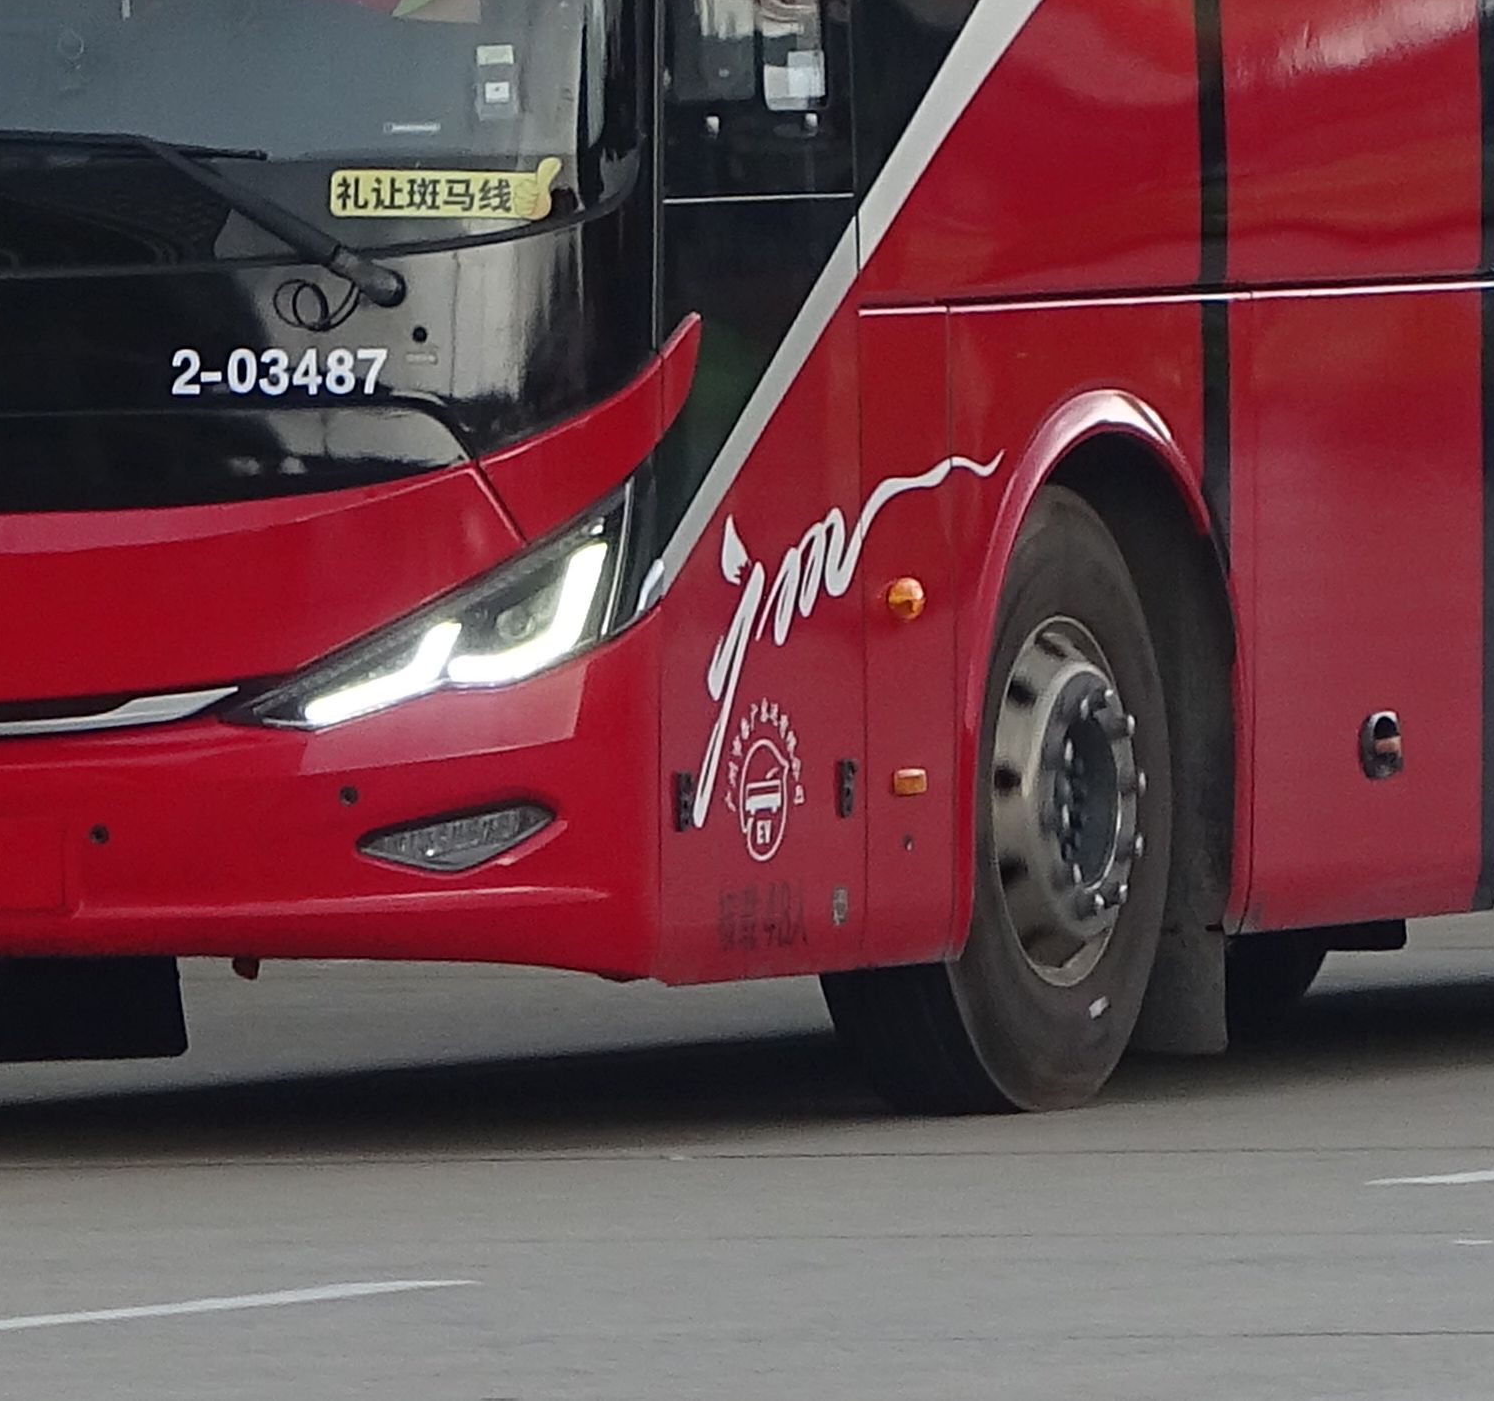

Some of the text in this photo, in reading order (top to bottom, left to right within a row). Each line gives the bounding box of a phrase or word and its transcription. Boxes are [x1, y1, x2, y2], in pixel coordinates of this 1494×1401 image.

[336, 175, 512, 213] 礼让斑马线
[171, 347, 389, 397] 2-03487
